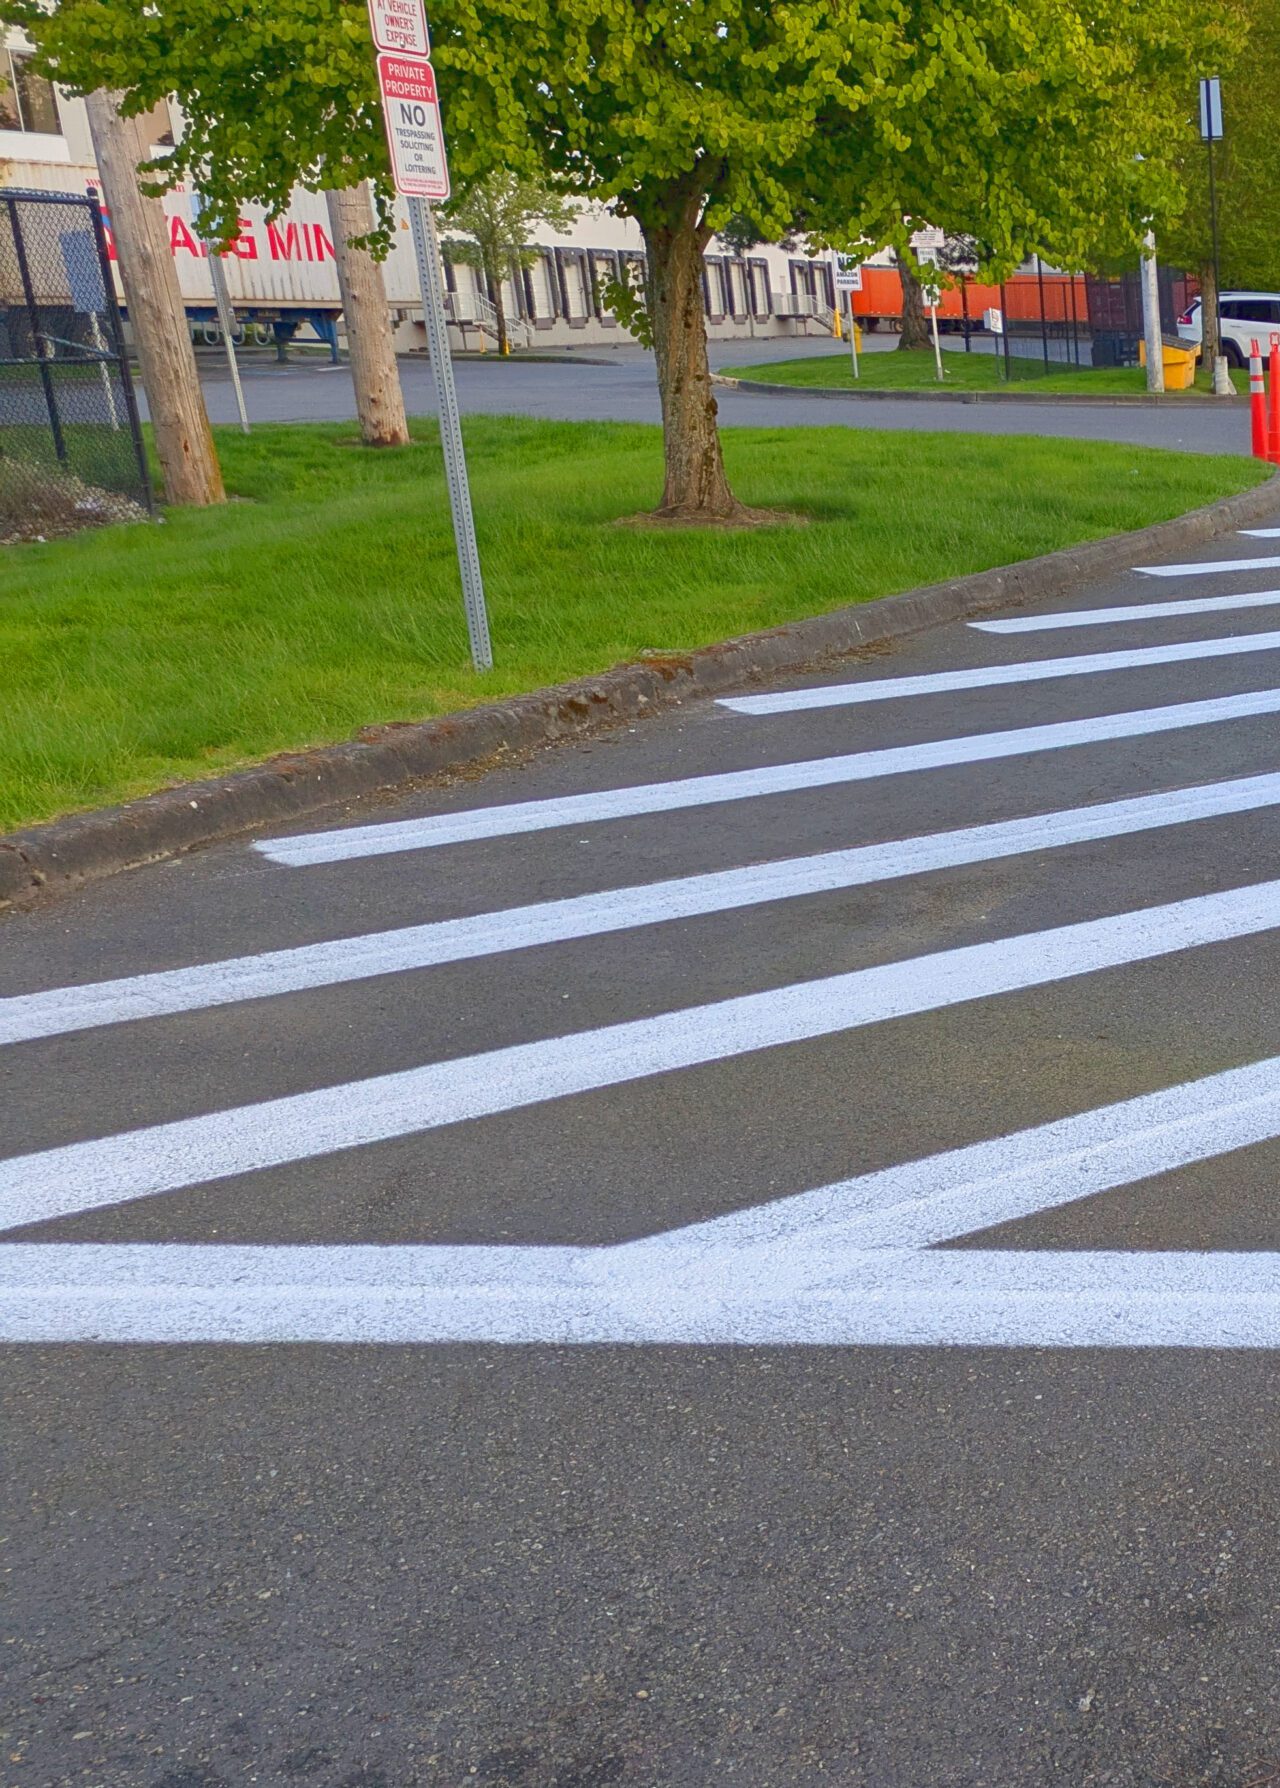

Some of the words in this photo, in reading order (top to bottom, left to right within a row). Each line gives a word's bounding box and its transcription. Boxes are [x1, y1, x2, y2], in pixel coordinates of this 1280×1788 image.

[387, 0, 418, 17] VEHICLE
[384, 14, 415, 31] OWNER'S
[386, 29, 418, 47] EXPENSE
[387, 62, 426, 82] PRIVATE
[384, 79, 433, 99] PROPERTY
[400, 103, 426, 127] NO
[396, 128, 436, 141] TRESPASSING
[400, 140, 434, 152] SOLICITING
[414, 153, 423, 161] OR
[405, 163, 436, 175] LOITERING
[267, 222, 336, 262] MIN
